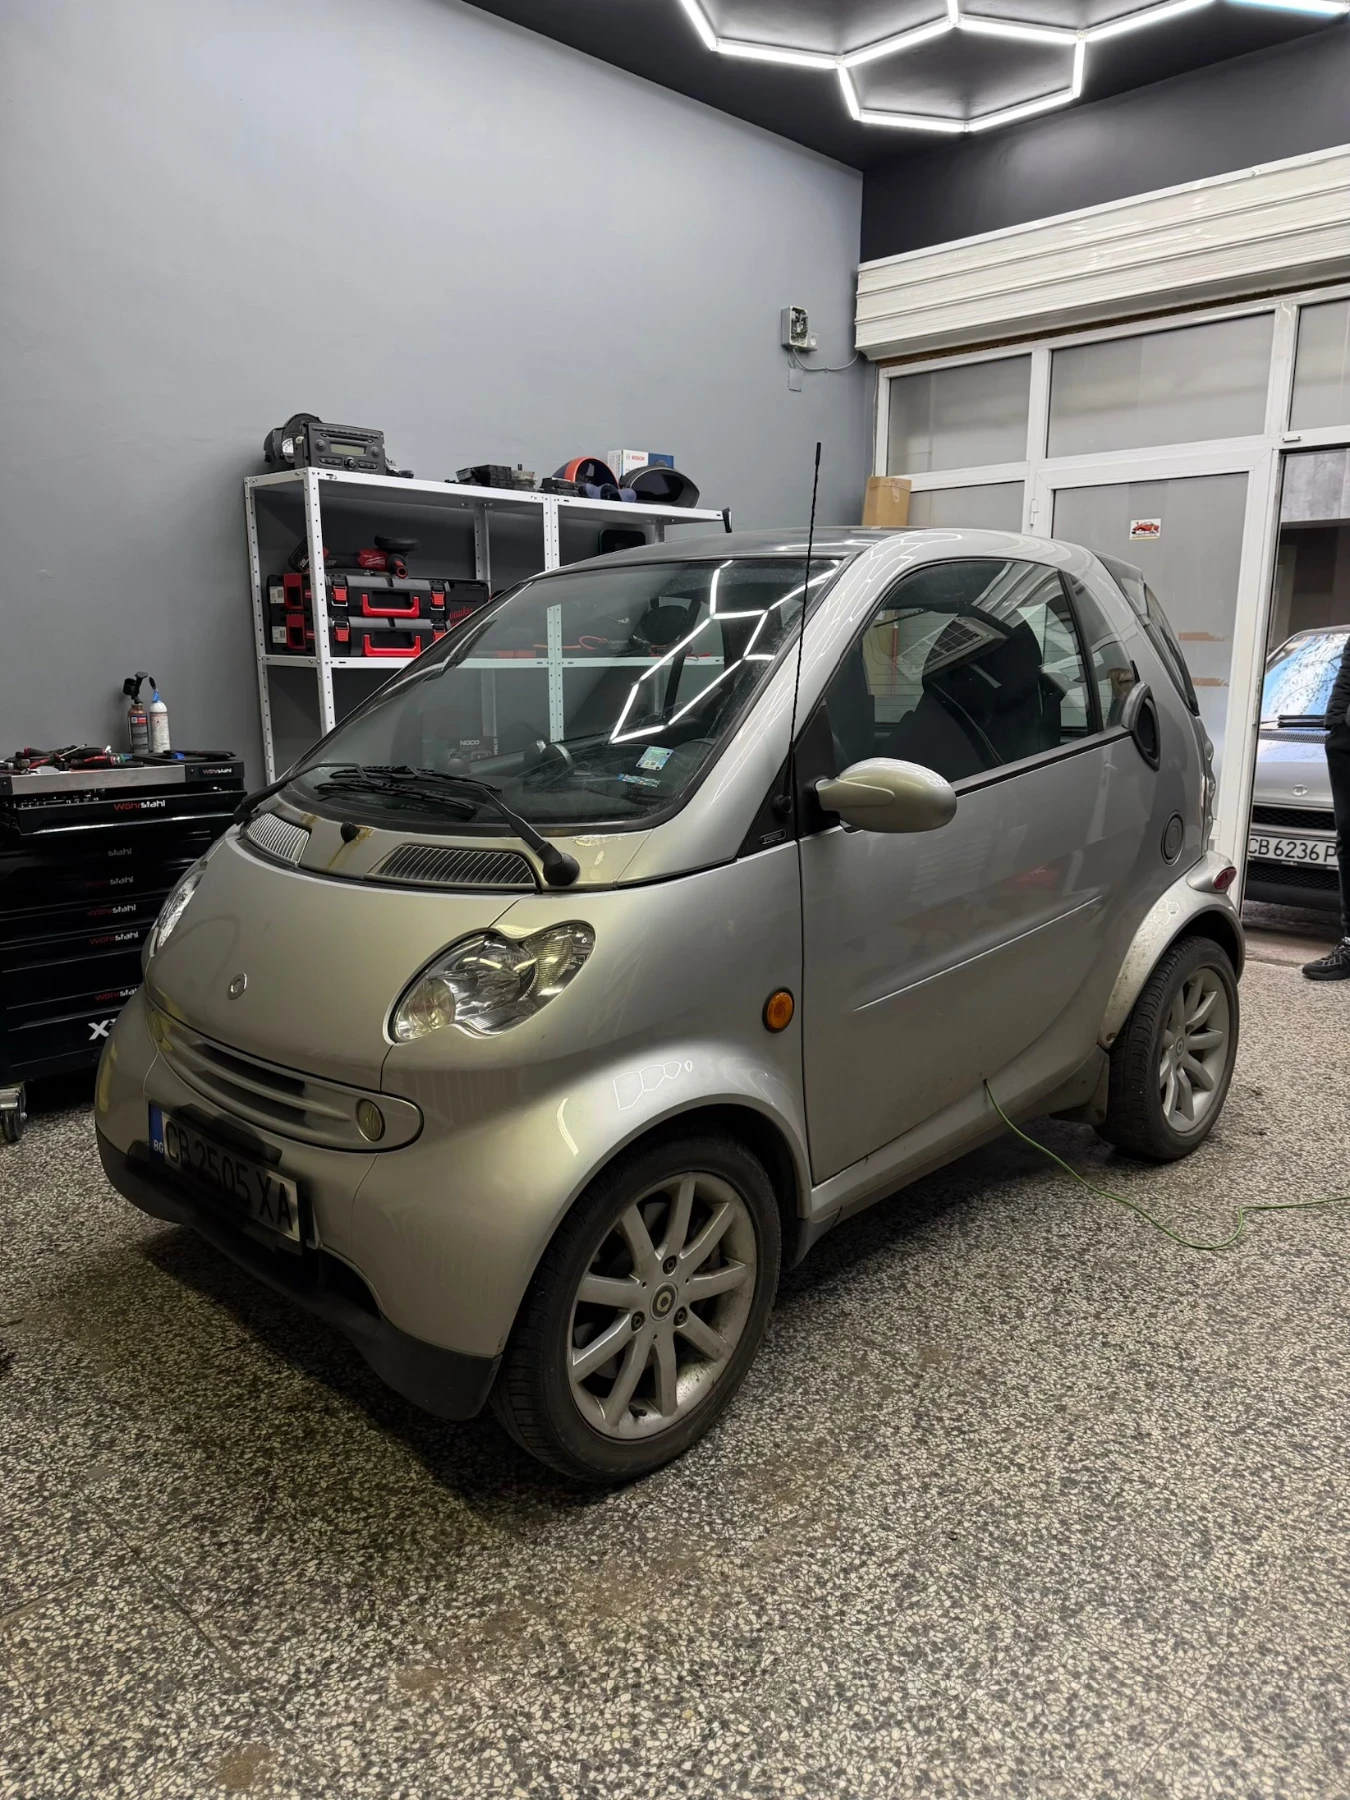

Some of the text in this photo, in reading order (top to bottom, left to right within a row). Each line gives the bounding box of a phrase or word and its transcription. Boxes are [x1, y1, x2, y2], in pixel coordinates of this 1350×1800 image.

[1248, 837, 1270, 855] CB
[1274, 840, 1319, 861] 6236
[153, 1139, 164, 1154] BG
[166, 1121, 294, 1231] CB 2505 XA
